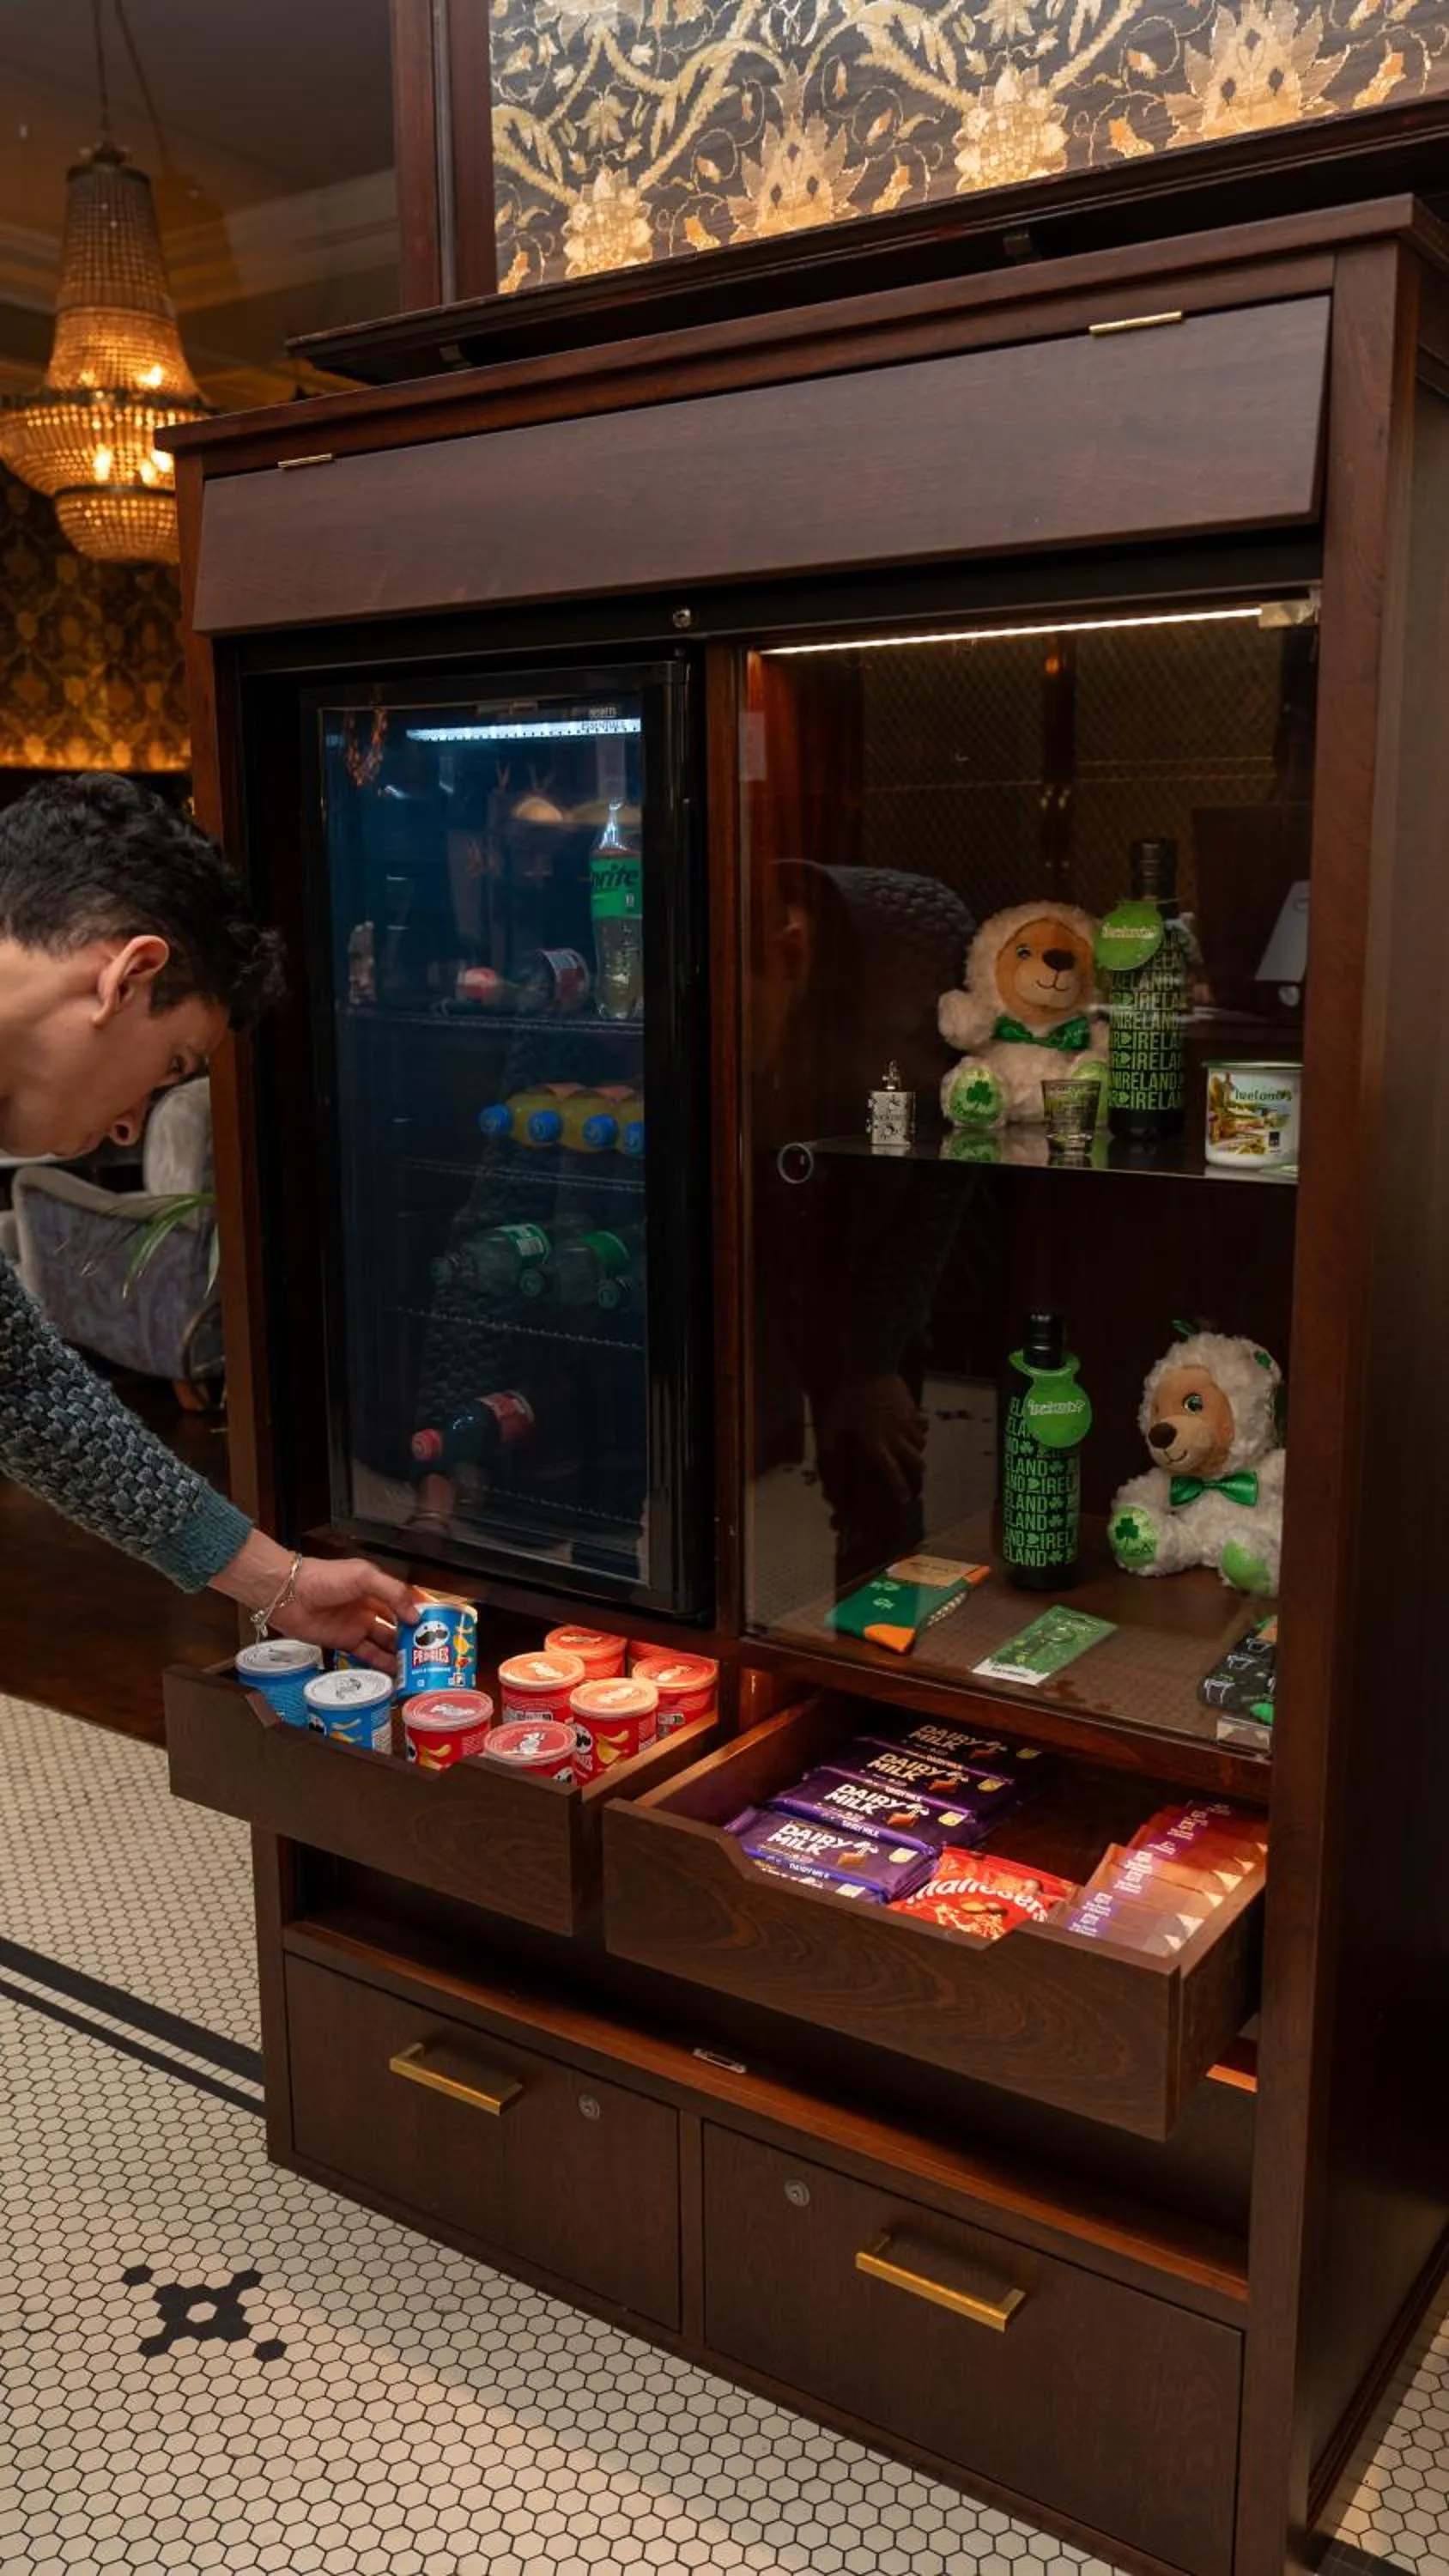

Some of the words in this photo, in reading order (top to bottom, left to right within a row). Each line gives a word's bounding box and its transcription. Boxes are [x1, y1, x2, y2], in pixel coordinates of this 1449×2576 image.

[907, 1730, 961, 1751] MILK
[920, 1725, 986, 1745] DAIRY
[866, 1759, 922, 1782] MILK
[879, 1753, 947, 1776] DAIRY
[824, 1790, 880, 1815] MILK
[837, 1783, 907, 1808] DAIRY
[767, 1832, 827, 1856] MILK
[779, 1823, 853, 1849] DAIRY
